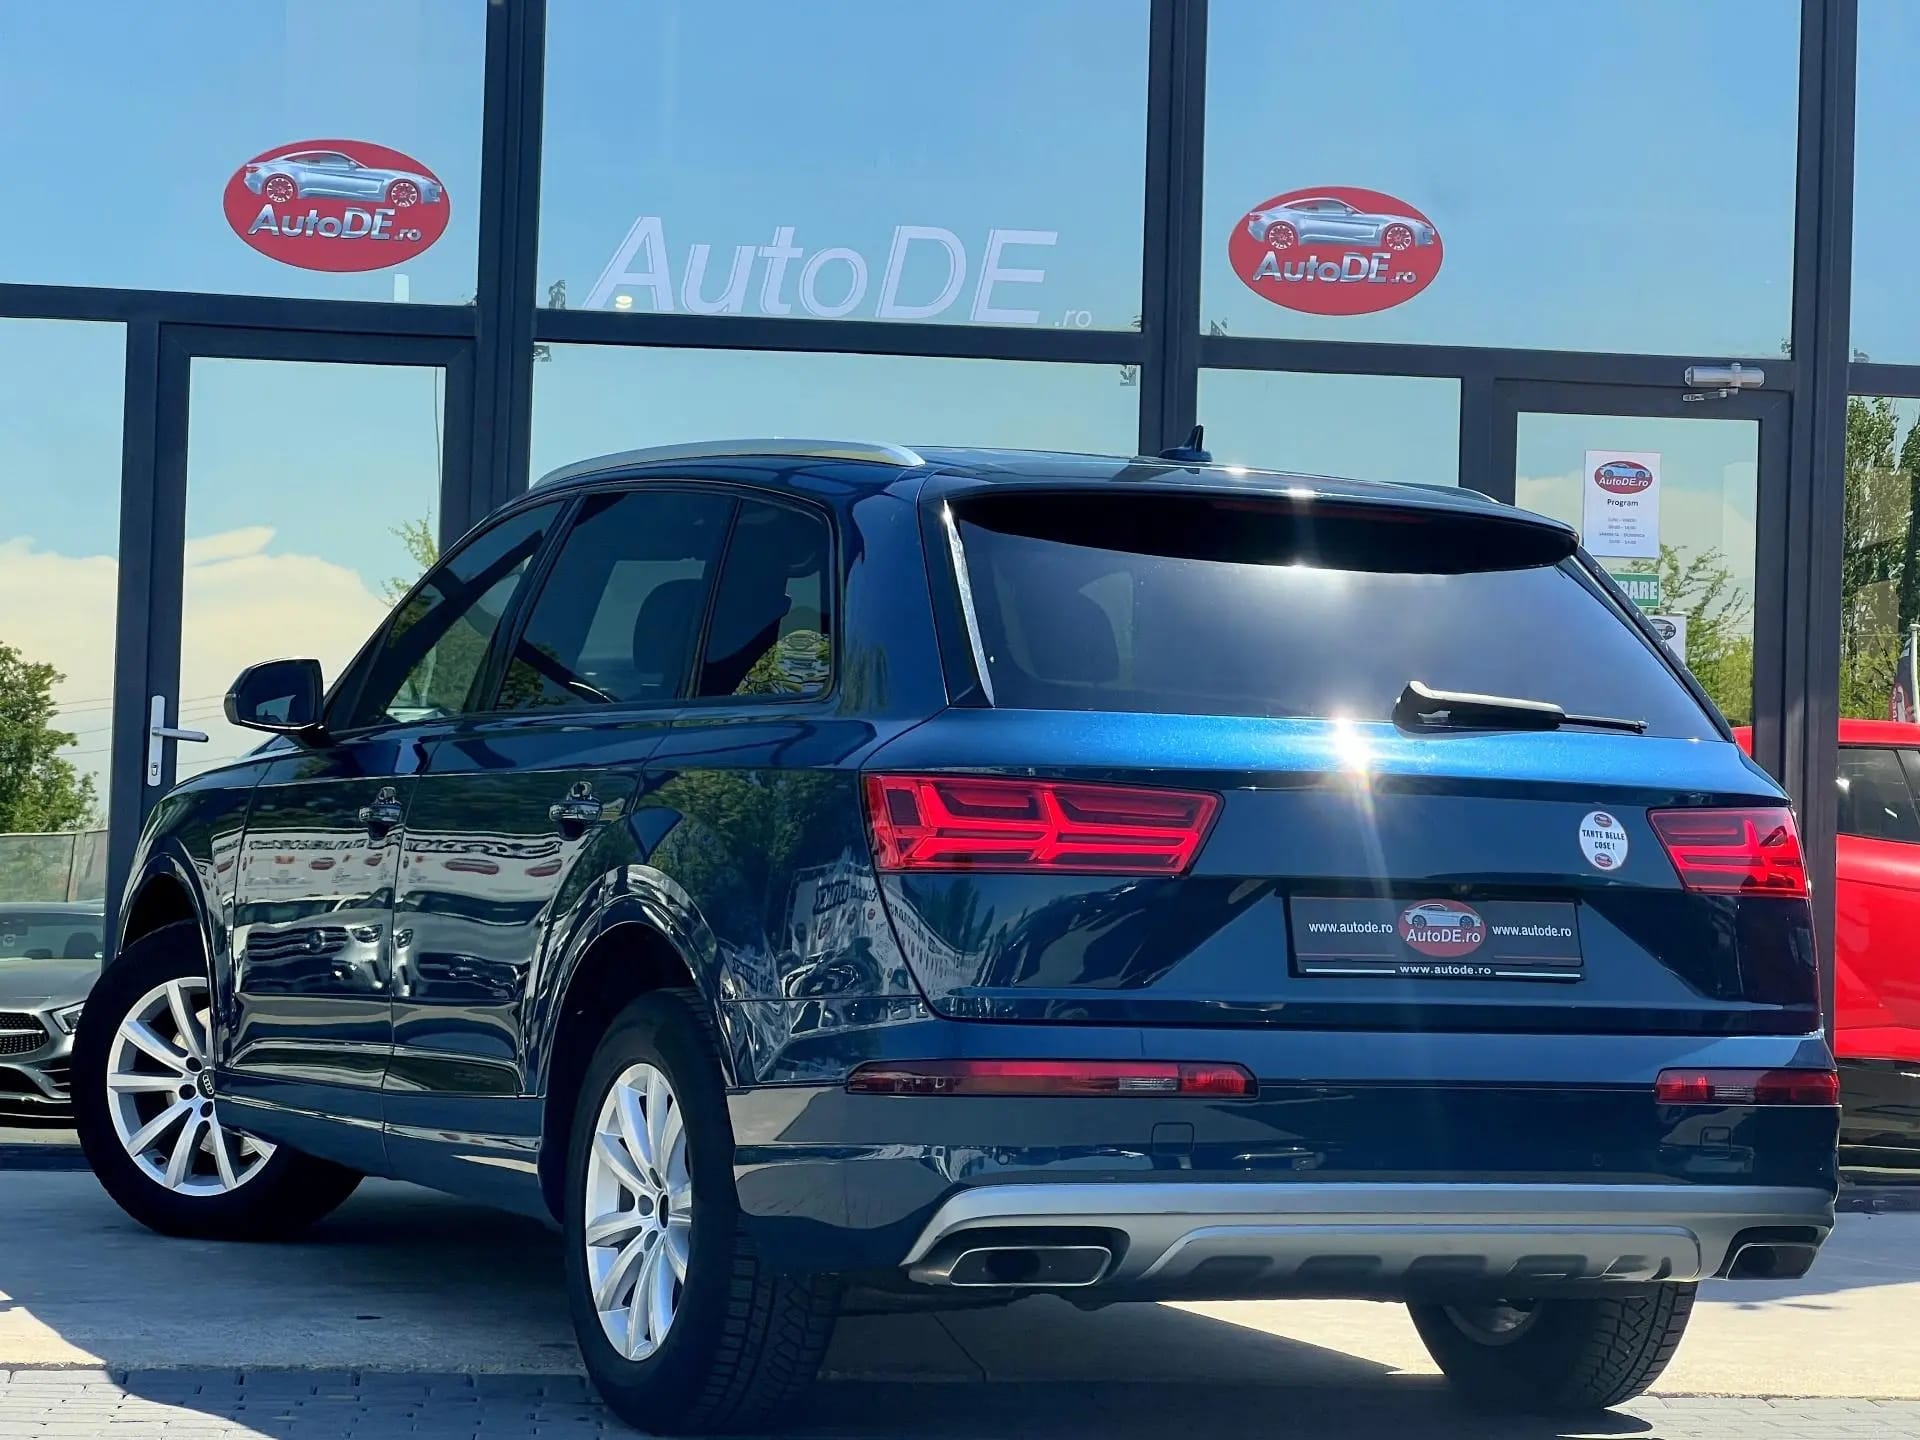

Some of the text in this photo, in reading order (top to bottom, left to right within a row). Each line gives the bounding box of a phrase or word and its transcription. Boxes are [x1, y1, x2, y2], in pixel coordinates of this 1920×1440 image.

[1607, 499, 1639, 507] Program
[1615, 580, 1657, 599] RARE
[1582, 830, 1625, 840] TANTE BELLE
[1594, 842, 1611, 850] COSE
[1309, 922, 1393, 934] www.autode.ro
[1492, 925, 1572, 937] www.autode.ro
[1406, 929, 1481, 943] AutoDE.ro
[1400, 965, 1492, 975] www.autode.ro
